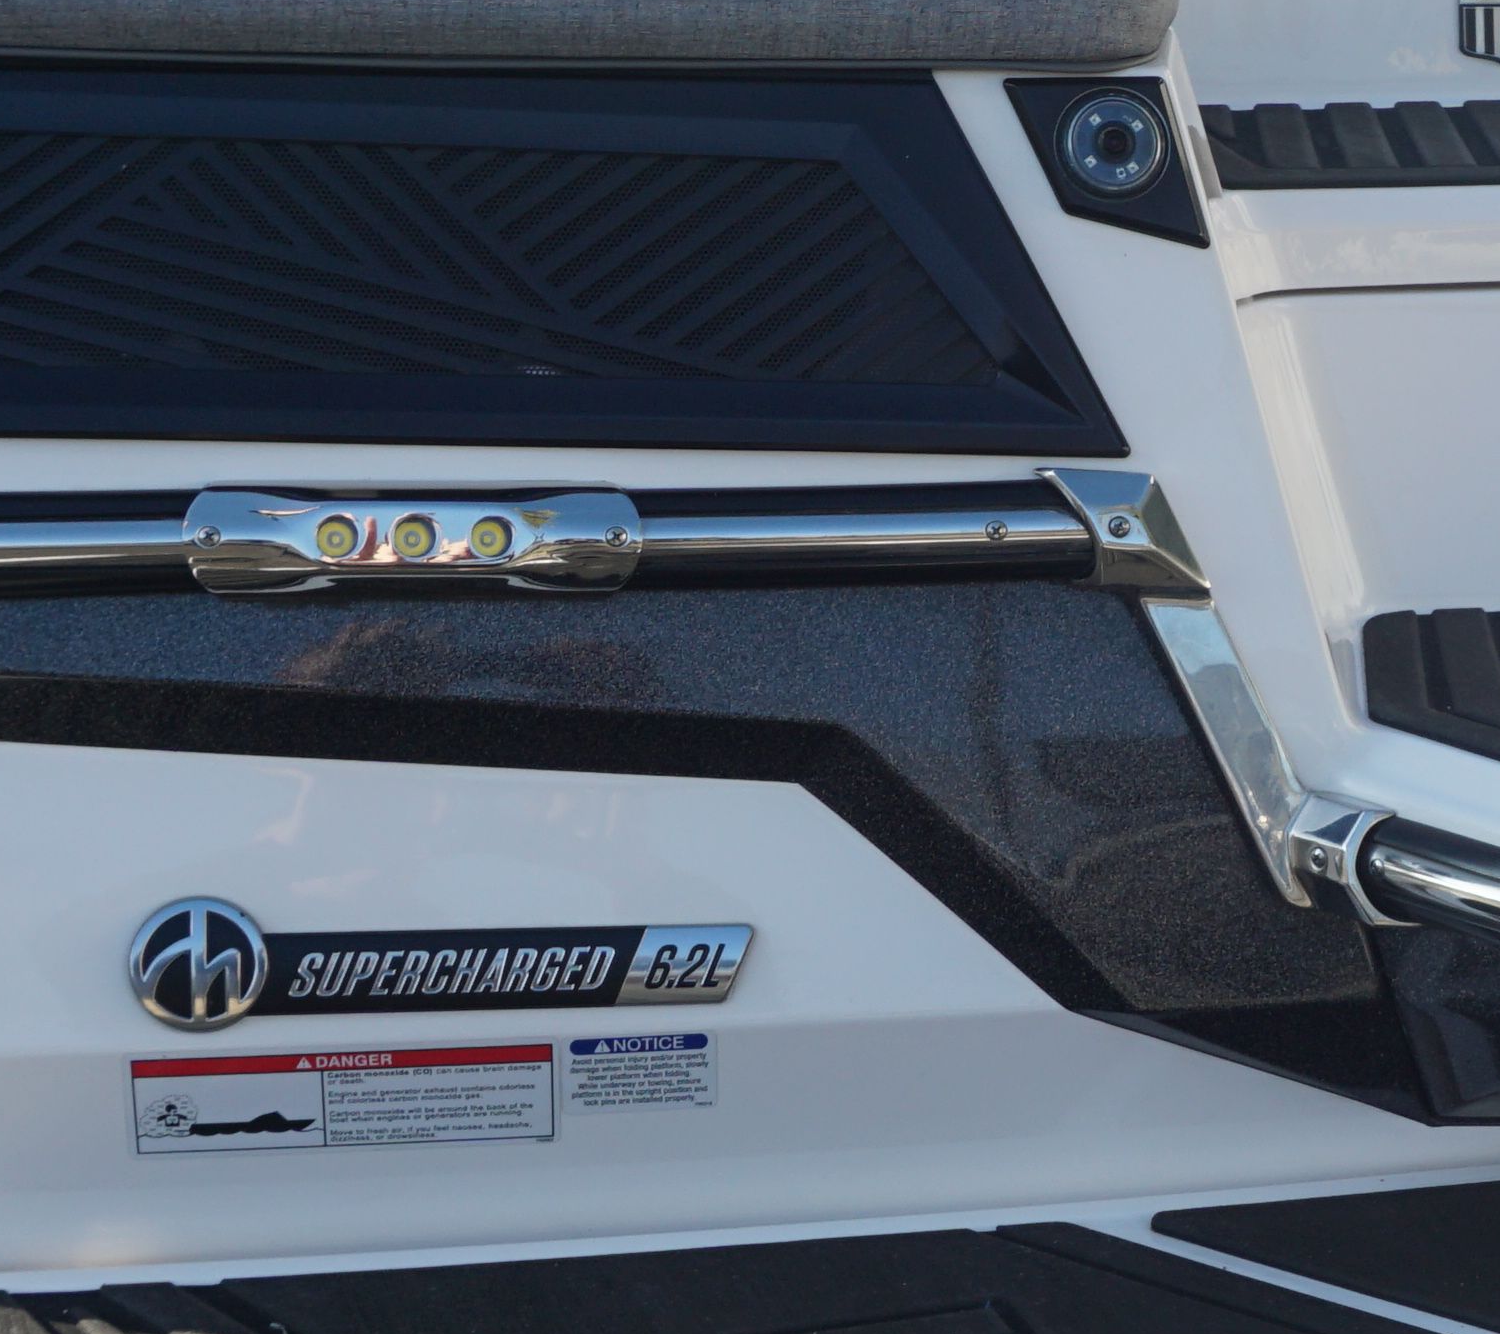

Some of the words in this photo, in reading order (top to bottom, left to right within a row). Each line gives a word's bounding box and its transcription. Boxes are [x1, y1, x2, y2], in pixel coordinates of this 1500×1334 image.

[288, 945, 616, 997] SUPERCHARGED
[644, 942, 726, 989] 6.2L
[613, 1036, 685, 1052] NOTICE
[316, 1053, 393, 1068] DANGER
